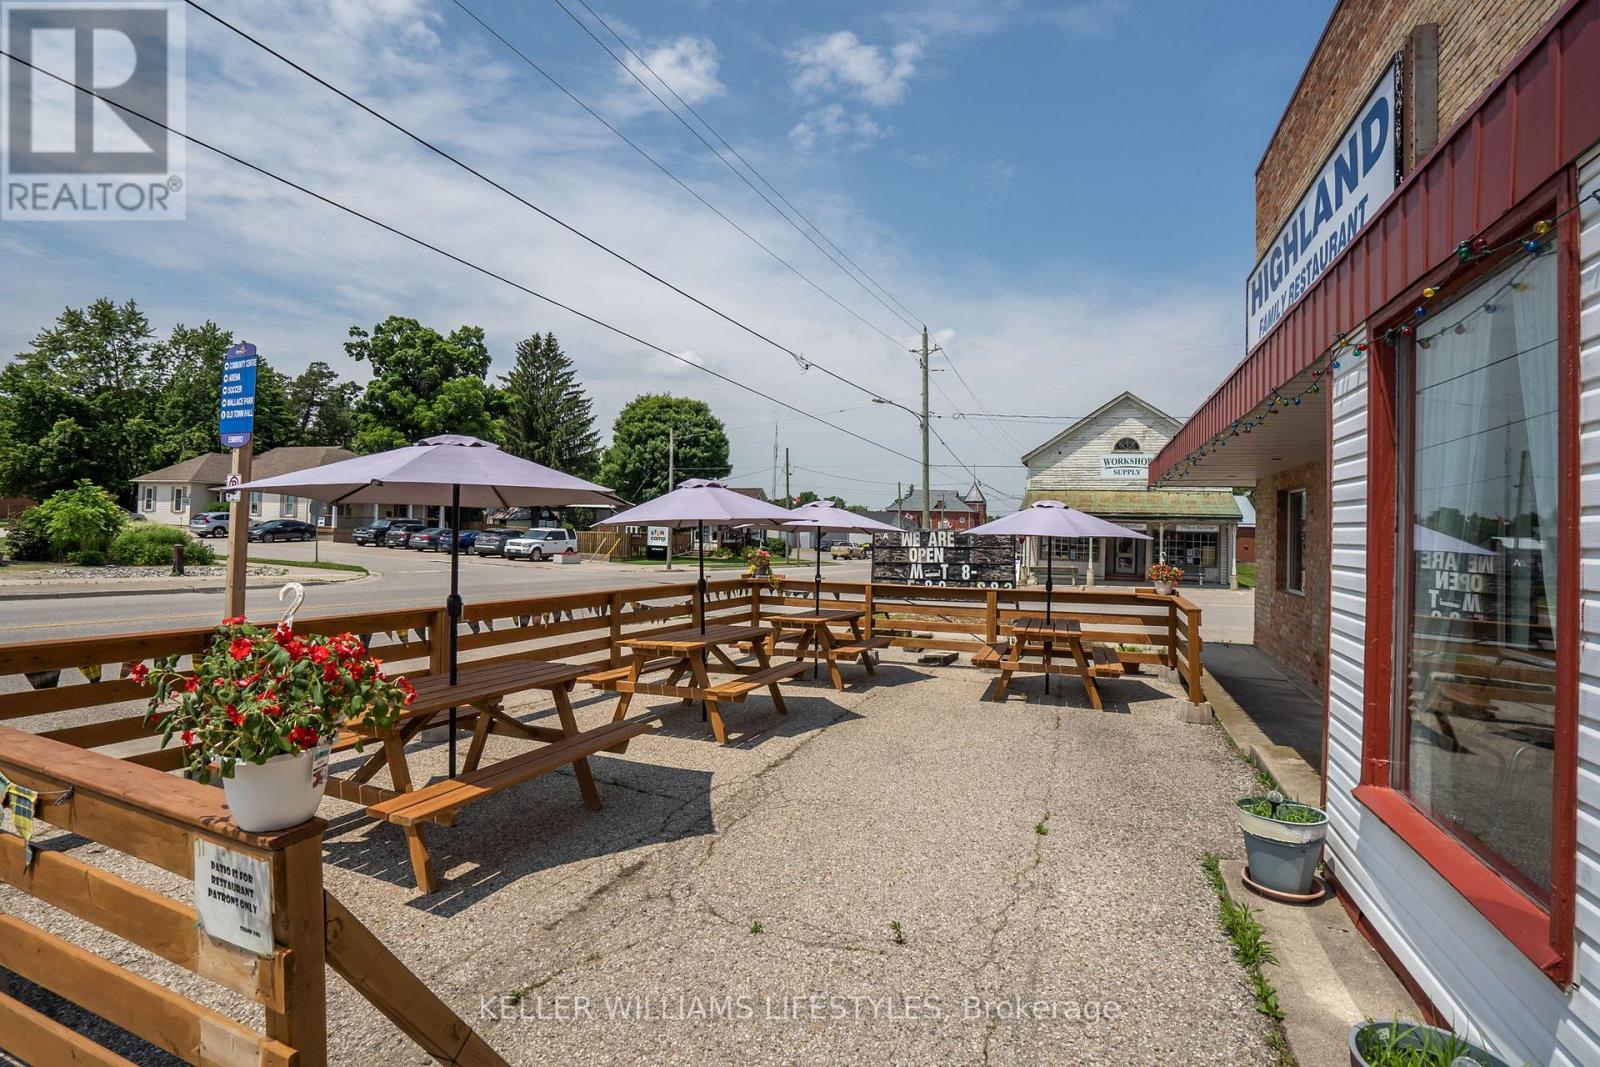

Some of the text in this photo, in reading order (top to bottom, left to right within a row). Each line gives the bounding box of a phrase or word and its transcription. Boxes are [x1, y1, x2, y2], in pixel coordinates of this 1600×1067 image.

[1250, 96, 1389, 316] HIGHLAND
[1258, 193, 1369, 339] FAMILY RESTAURANT
[227, 386, 242, 394] SOCCER
[227, 397, 254, 407] WALLACE PARK
[233, 410, 244, 418] TOWN
[1113, 468, 1141, 476] SUPPLY
[901, 531, 955, 547] WE ARE
[909, 547, 944, 563] OPEN
[210, 860, 254, 884] PATIO IS FOR
[211, 874, 254, 898] RESTAURANT
[208, 888, 258, 914] PATRONS ONLY
